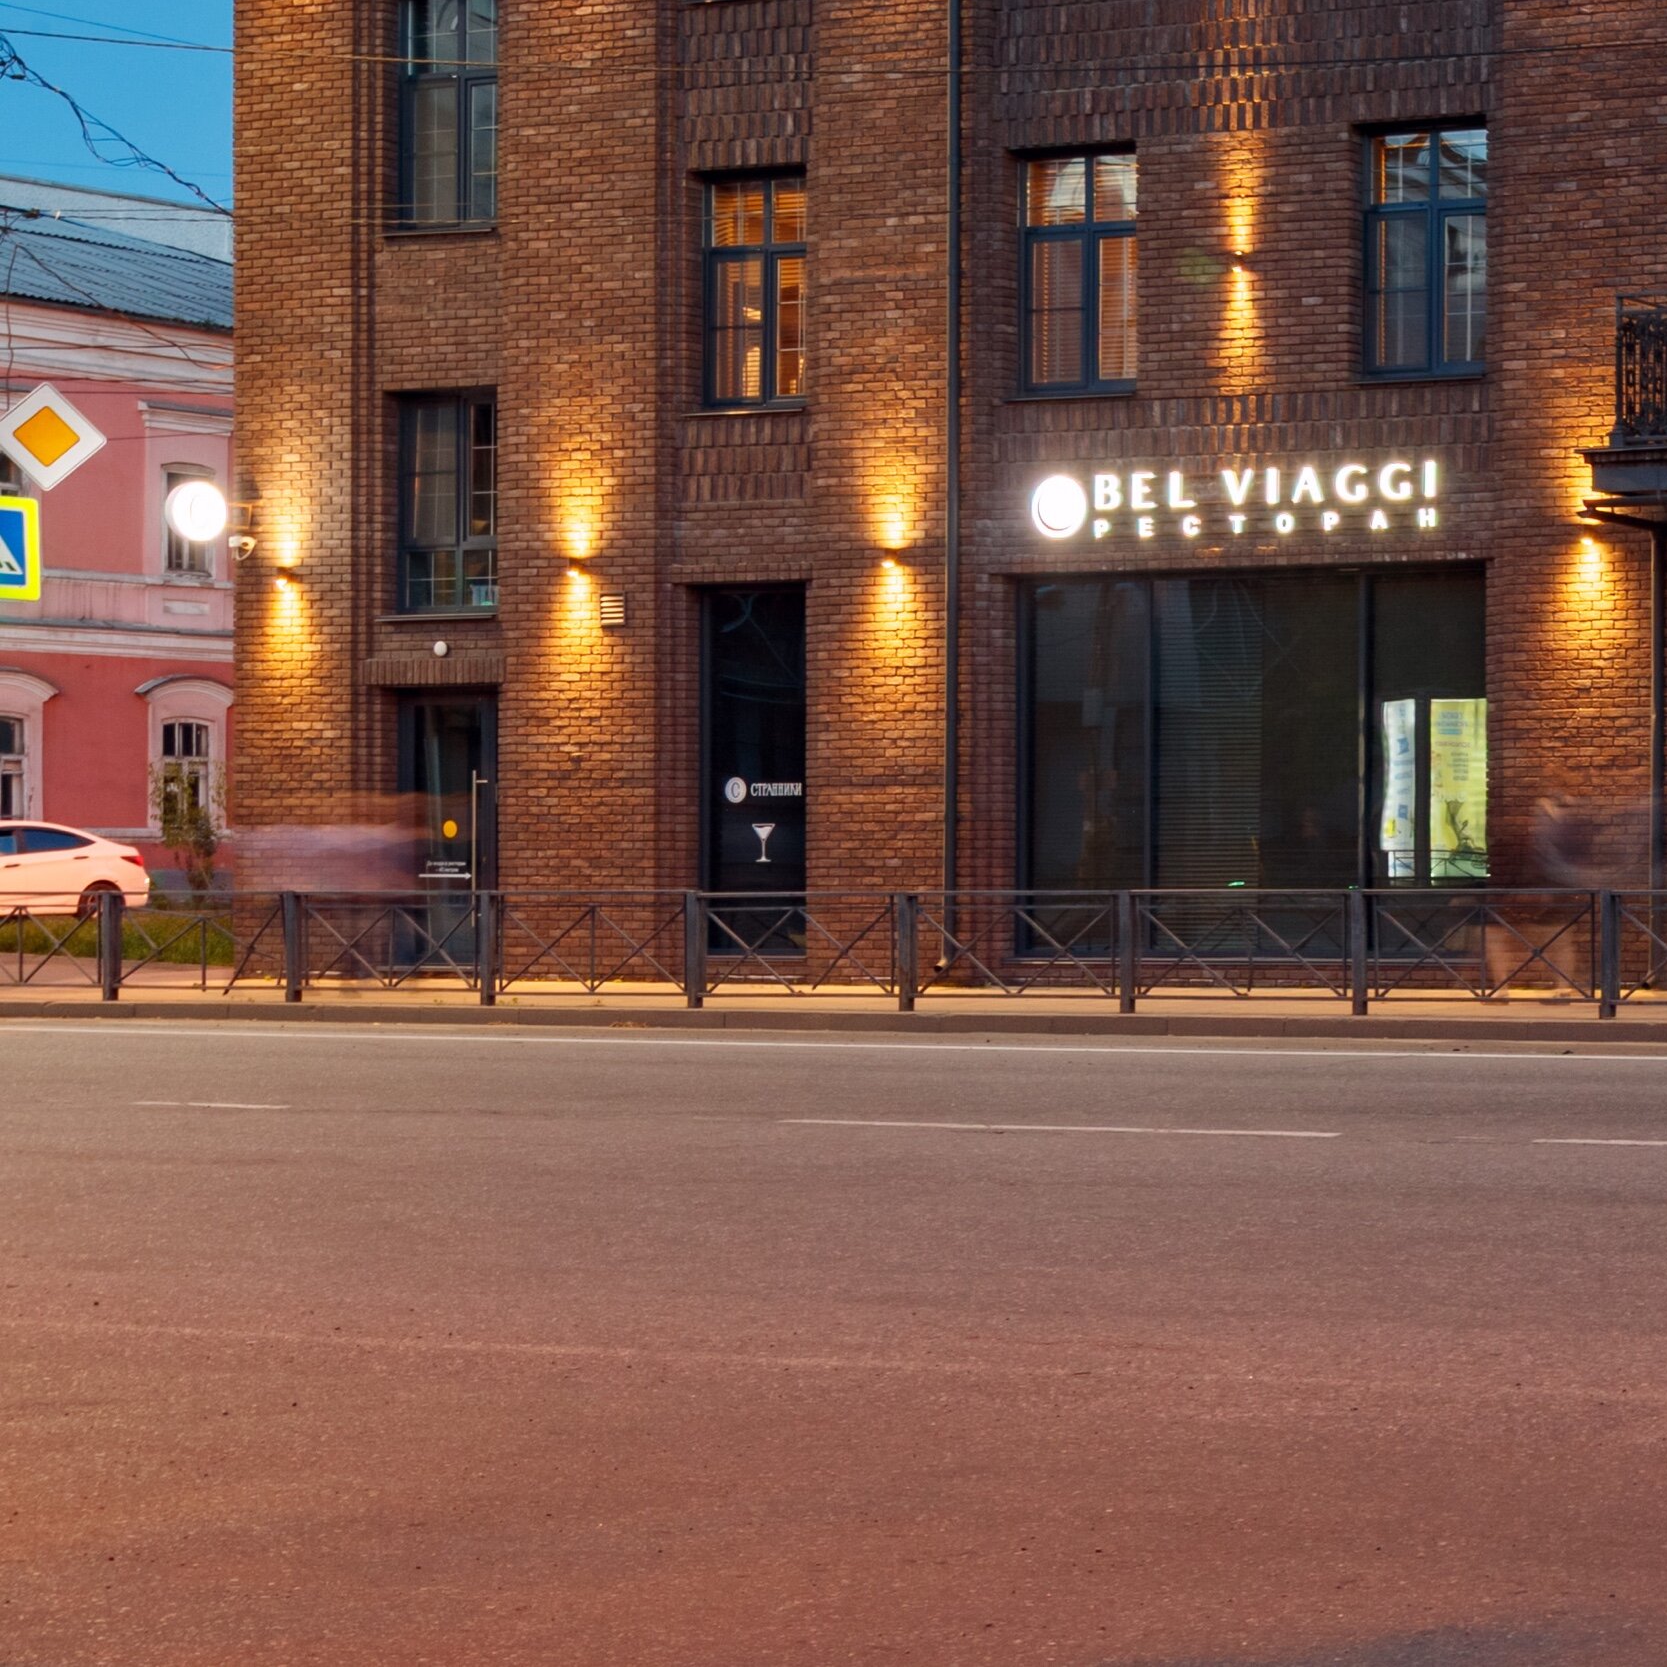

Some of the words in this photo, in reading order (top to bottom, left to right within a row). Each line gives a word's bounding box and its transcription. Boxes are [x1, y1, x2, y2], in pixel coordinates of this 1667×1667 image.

[1094, 470, 1197, 510] BEL
[1222, 460, 1437, 505] VIAGGI
[1094, 507, 1437, 538] РЕСТОРАН
